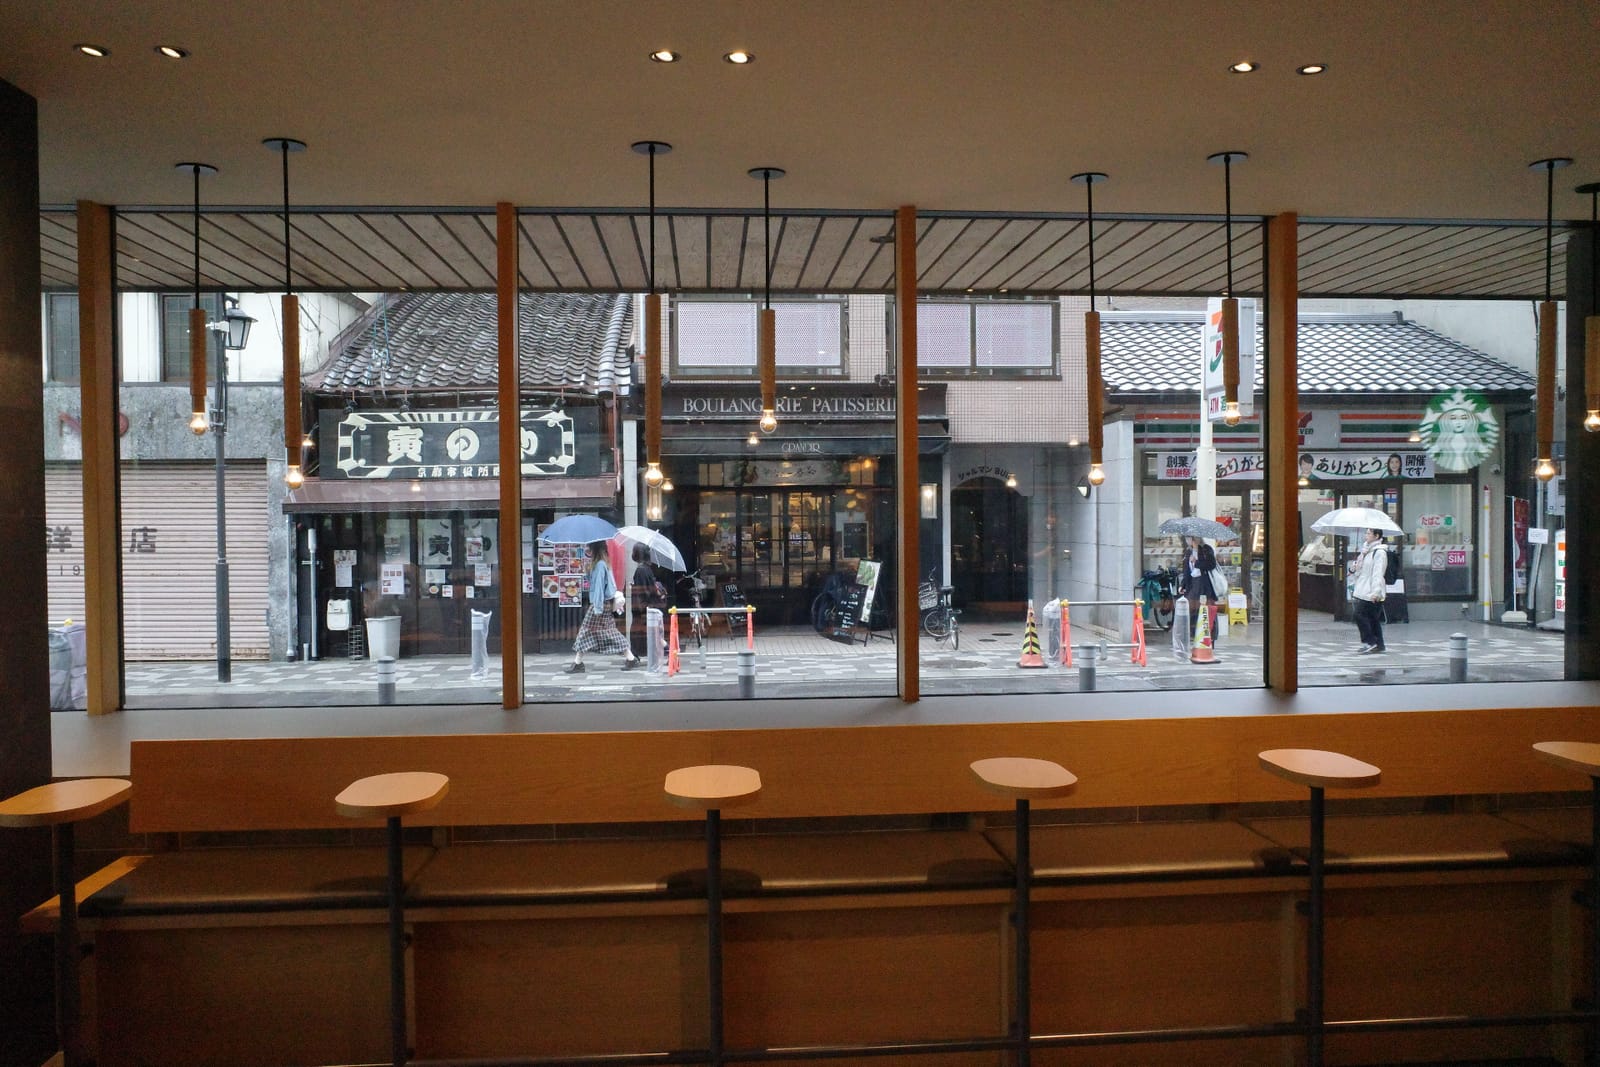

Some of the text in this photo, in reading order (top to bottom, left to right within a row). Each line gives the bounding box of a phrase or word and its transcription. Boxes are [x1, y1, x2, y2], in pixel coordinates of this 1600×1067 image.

[682, 397, 802, 413] BOULANGRIE
[1166, 456, 1189, 468] 創業
[1316, 456, 1383, 476] ありがとう
[1405, 455, 1426, 467] 開催
[1448, 555, 1465, 563] SIM
